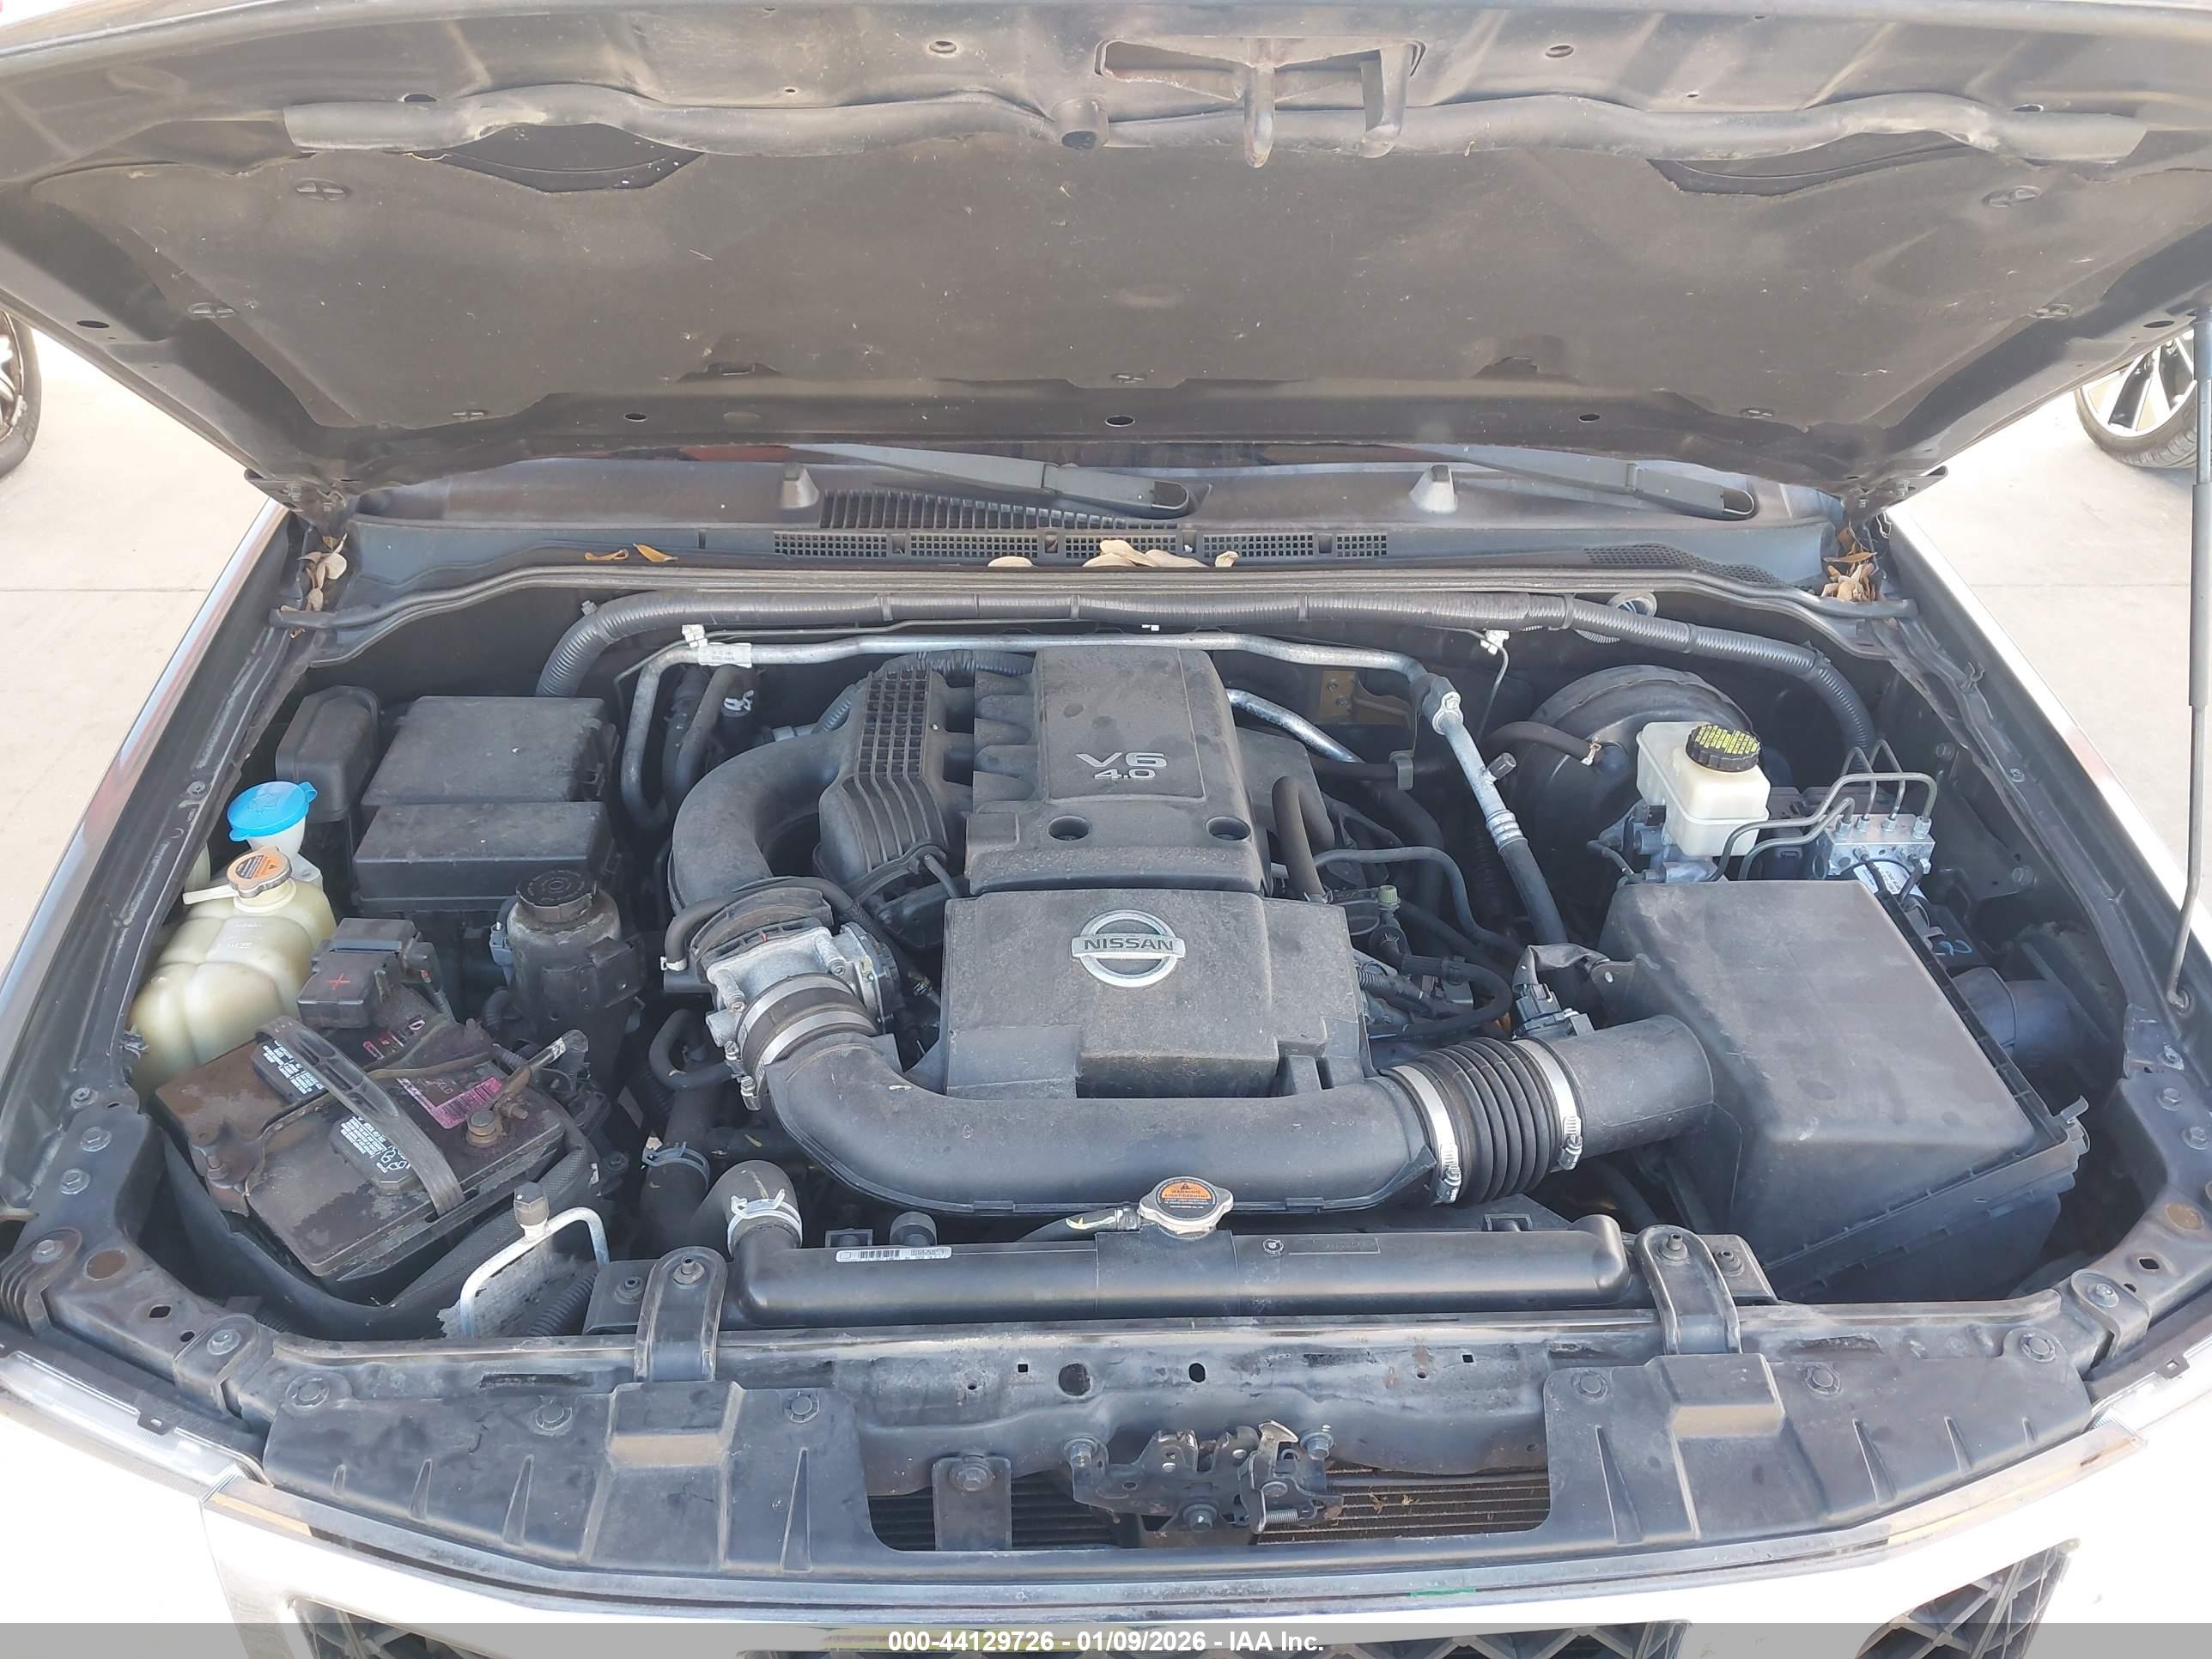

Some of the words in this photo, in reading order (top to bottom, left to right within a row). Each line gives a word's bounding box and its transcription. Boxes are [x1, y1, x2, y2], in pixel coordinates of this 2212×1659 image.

[1075, 751, 1168, 768] V6
[1093, 769, 1157, 780] 4.0
[1084, 938, 1174, 951] NISSAN
